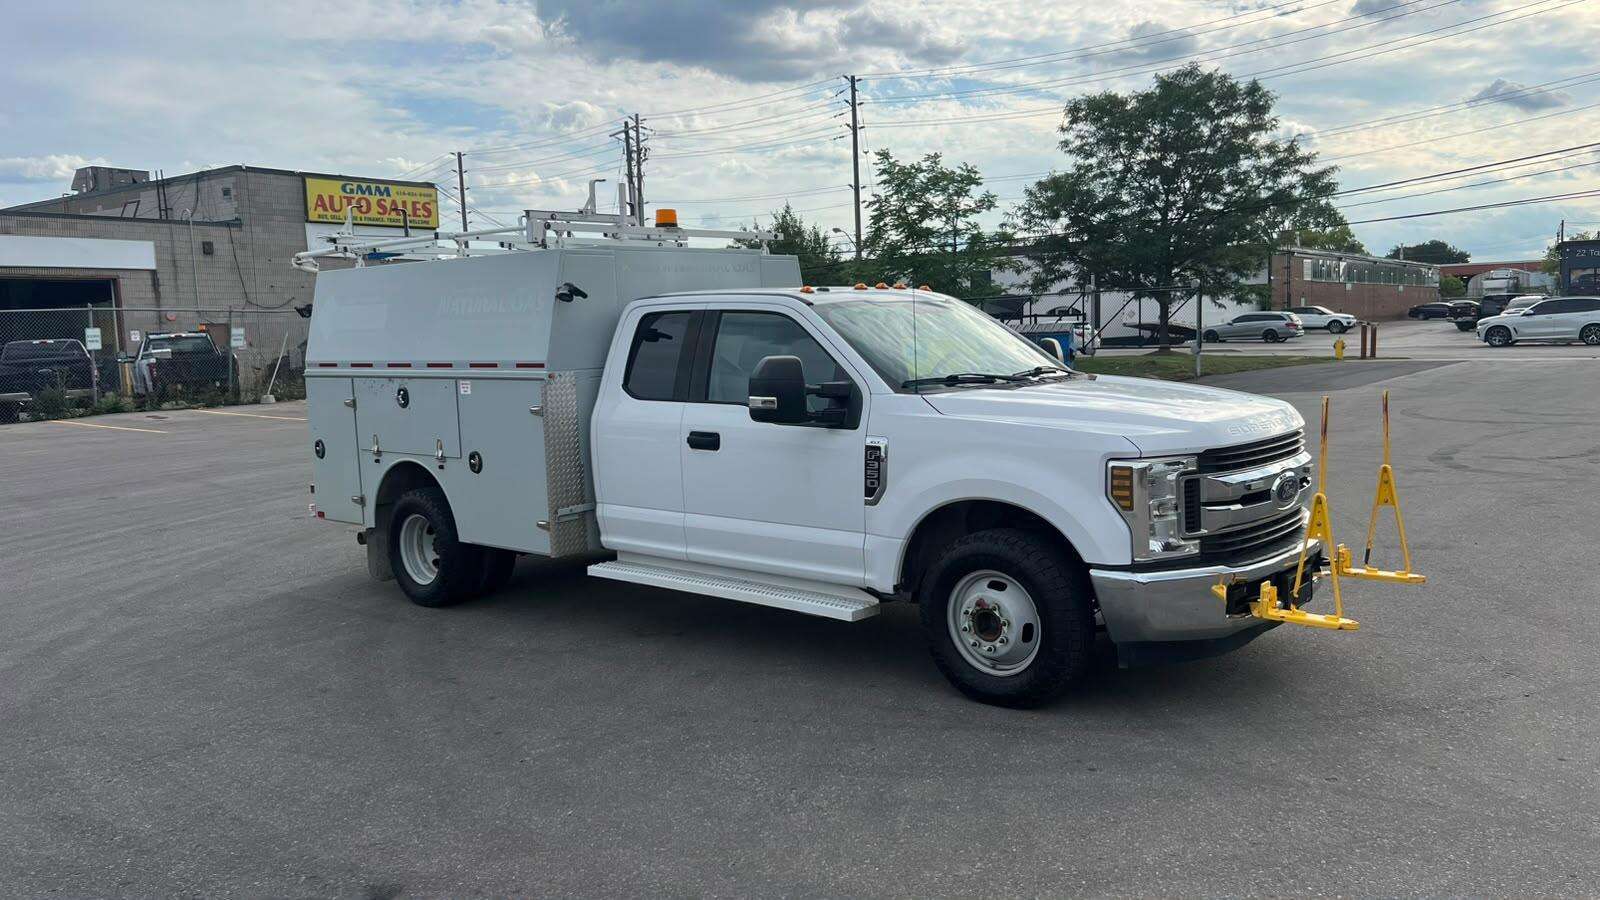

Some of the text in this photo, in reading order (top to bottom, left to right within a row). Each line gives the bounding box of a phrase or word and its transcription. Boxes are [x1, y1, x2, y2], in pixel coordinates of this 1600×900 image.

[341, 183, 391, 197] GMM
[314, 194, 432, 219] AUTO SALES
[1576, 249, 1586, 257] 22
